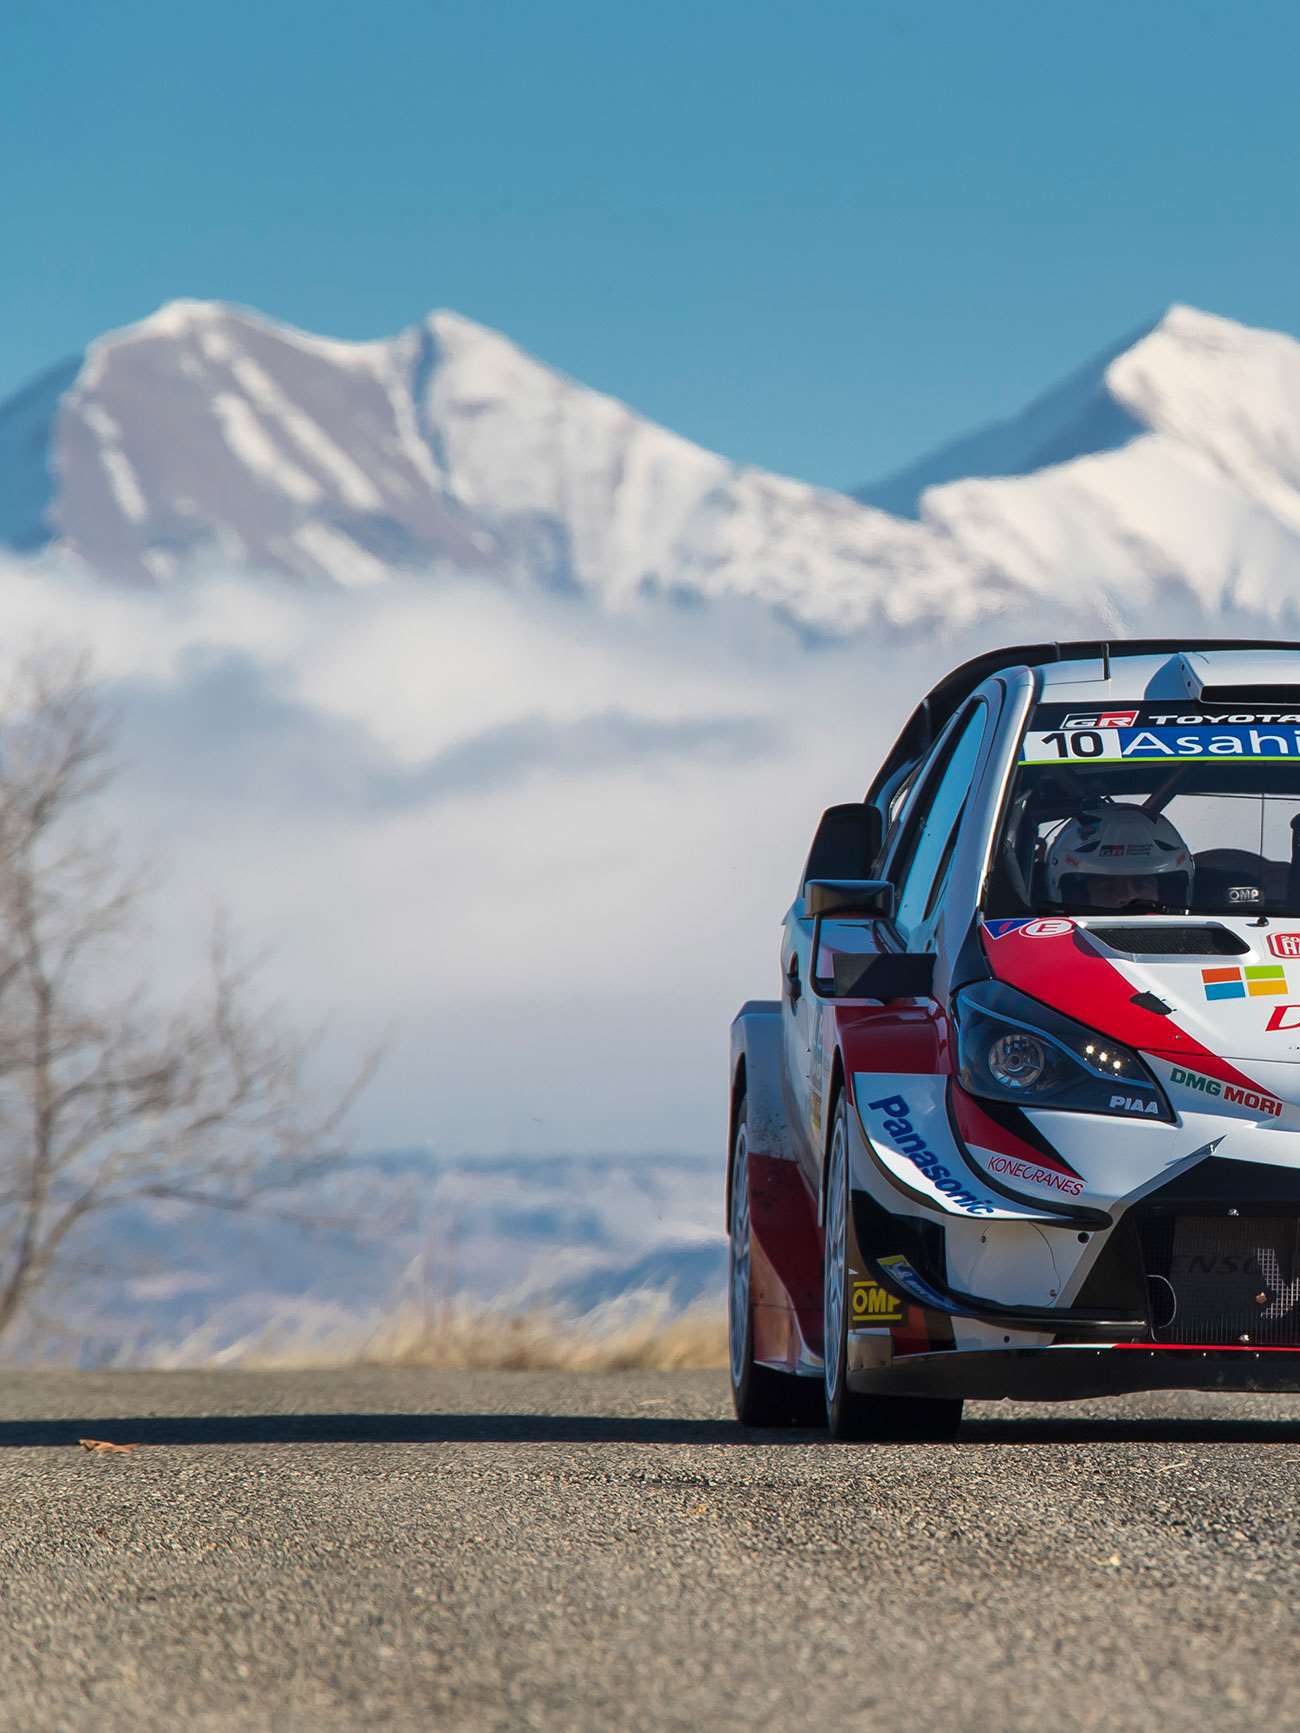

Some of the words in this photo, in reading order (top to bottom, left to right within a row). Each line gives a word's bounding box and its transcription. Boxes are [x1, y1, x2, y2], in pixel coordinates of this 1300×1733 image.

[1041, 730, 1105, 759] 10
[1229, 888, 1260, 900] OMP
[1036, 922, 1062, 933] E
[1109, 1095, 1160, 1115] PIAA
[1170, 1067, 1222, 1097] DMG
[1224, 1085, 1283, 1118] MORI
[868, 1094, 996, 1216] Panasonic
[987, 1156, 1084, 1197] KONECRANES
